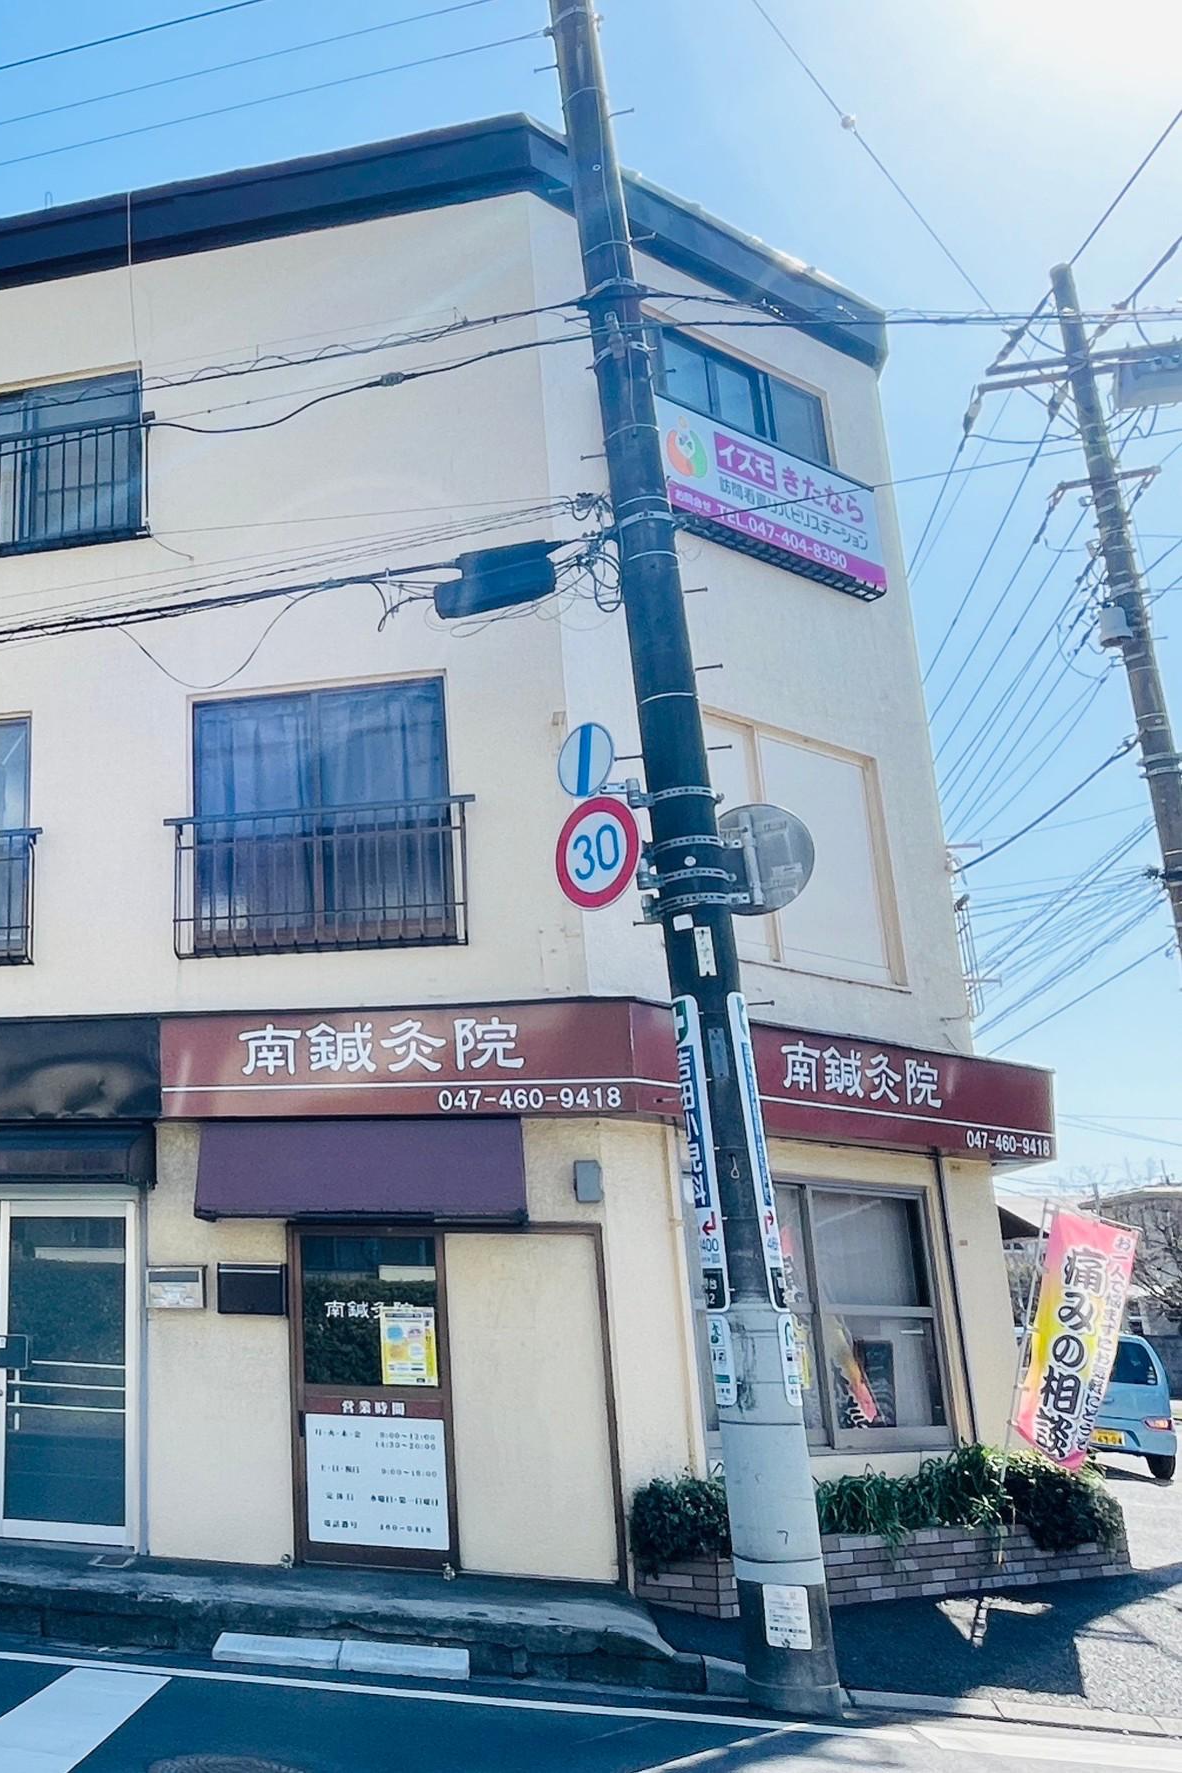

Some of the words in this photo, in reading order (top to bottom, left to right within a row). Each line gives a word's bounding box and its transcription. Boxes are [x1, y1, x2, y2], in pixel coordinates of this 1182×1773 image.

[781, 466, 864, 524] きたなら
[573, 824, 618, 880] 30
[238, 1016, 524, 1076] 南鍼灸院
[437, 1086, 622, 1111] 047-460-9418
[780, 1040, 943, 1109] 南鍼灸院
[966, 1130, 1051, 1157] 047-460-9418
[341, 1400, 406, 1416] 営業時間
